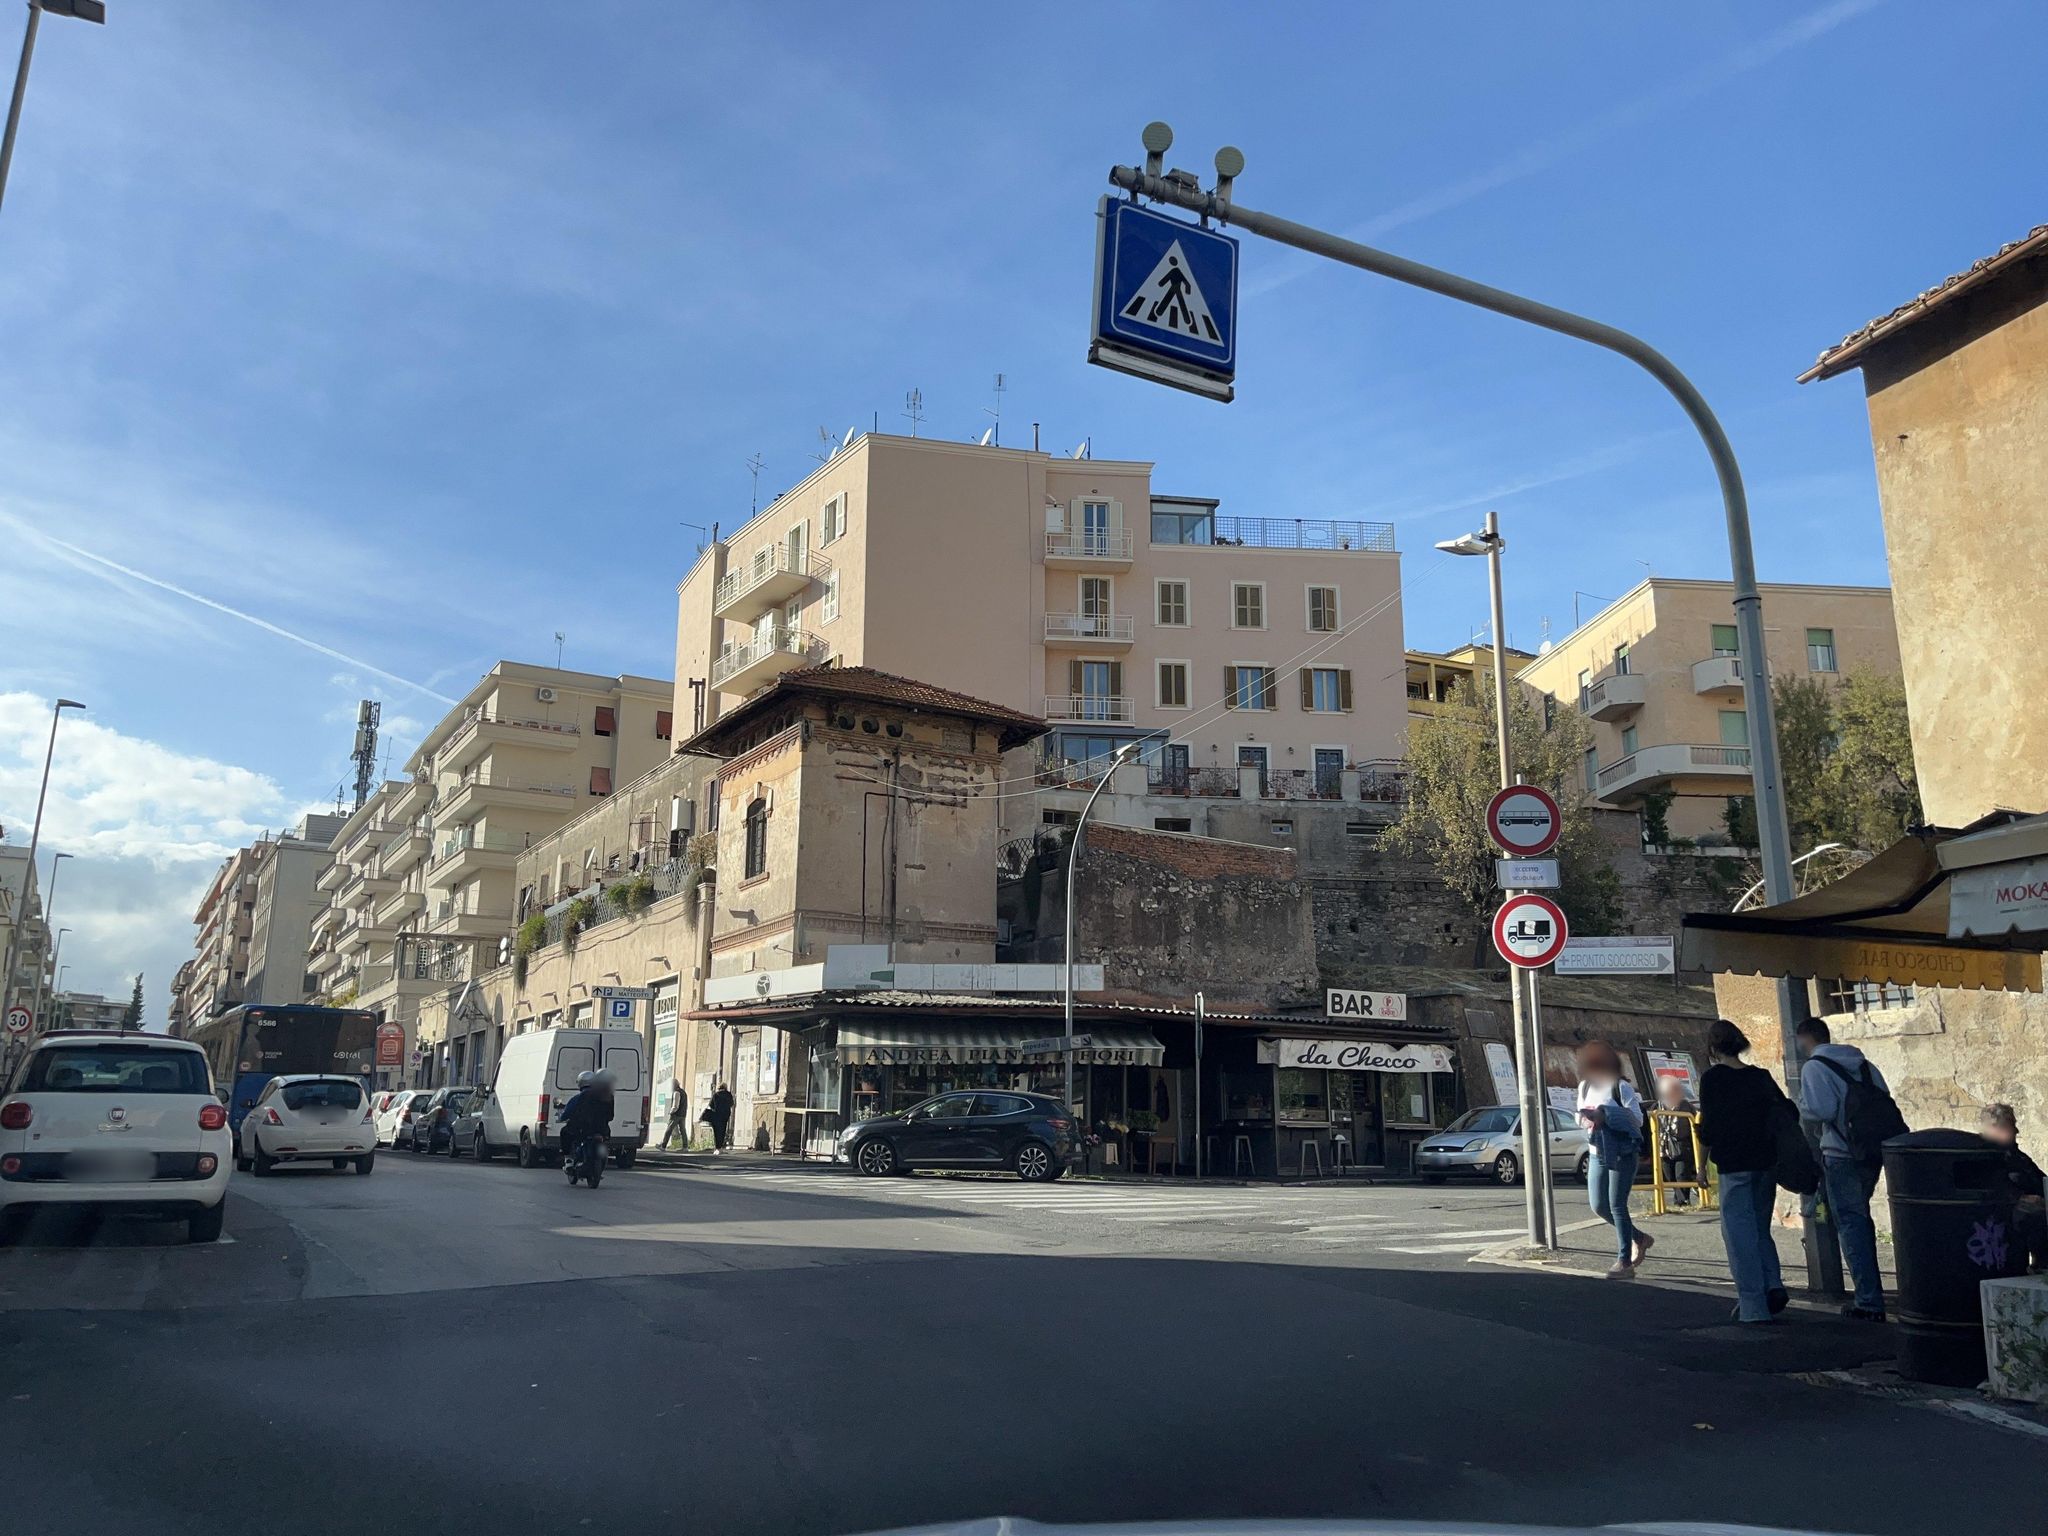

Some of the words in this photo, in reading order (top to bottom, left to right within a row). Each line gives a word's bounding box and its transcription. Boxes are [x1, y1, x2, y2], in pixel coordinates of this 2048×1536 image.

[1571, 954, 1606, 967] PRONTO
[1607, 953, 1656, 967] SOCCORSO
[1331, 993, 1373, 1015] BAR
[10, 1014, 26, 1026] 30
[868, 1049, 952, 1061] ANDREA
[1080, 1050, 1134, 1061] FIORI
[1297, 1044, 1332, 1065] da
[1337, 1046, 1421, 1068] Checco
